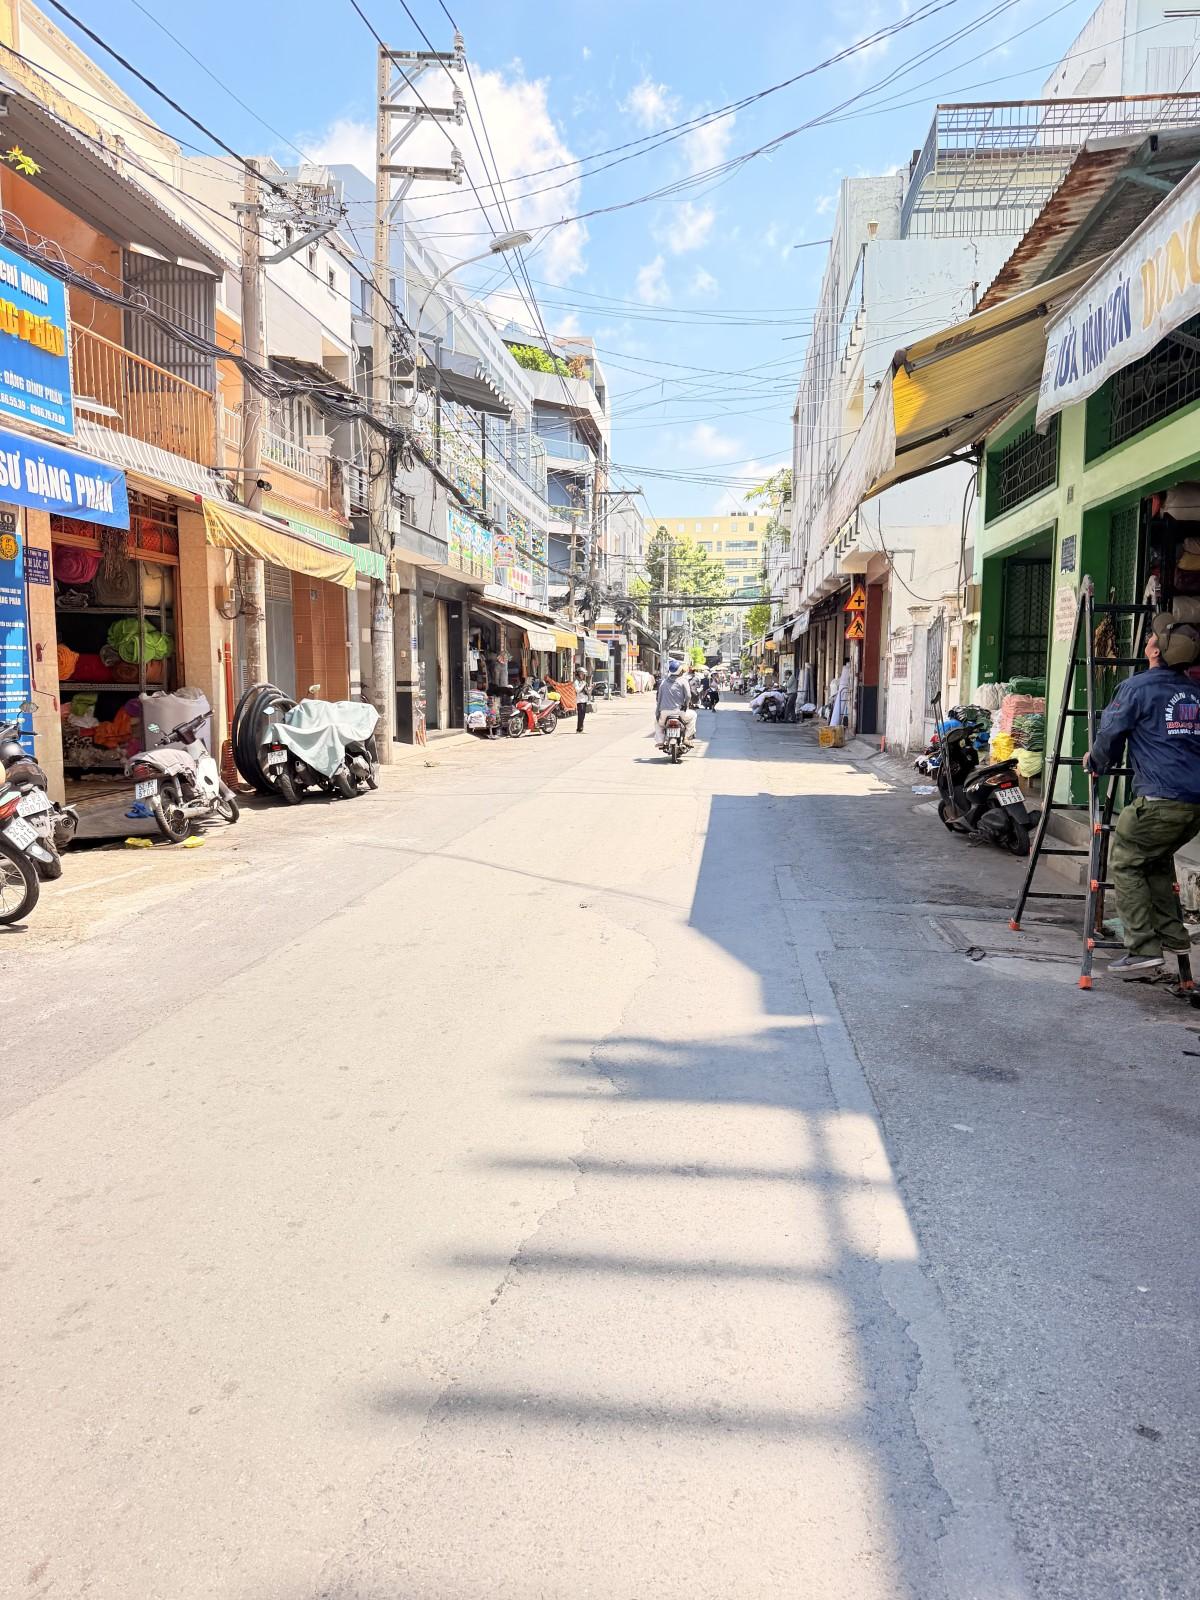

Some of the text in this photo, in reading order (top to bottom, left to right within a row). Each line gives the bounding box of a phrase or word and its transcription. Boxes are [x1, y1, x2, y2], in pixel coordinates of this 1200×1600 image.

[21, 271, 48, 306] MINH
[24, 456, 73, 504] ĐẶNG
[75, 474, 114, 514] PHÁN
